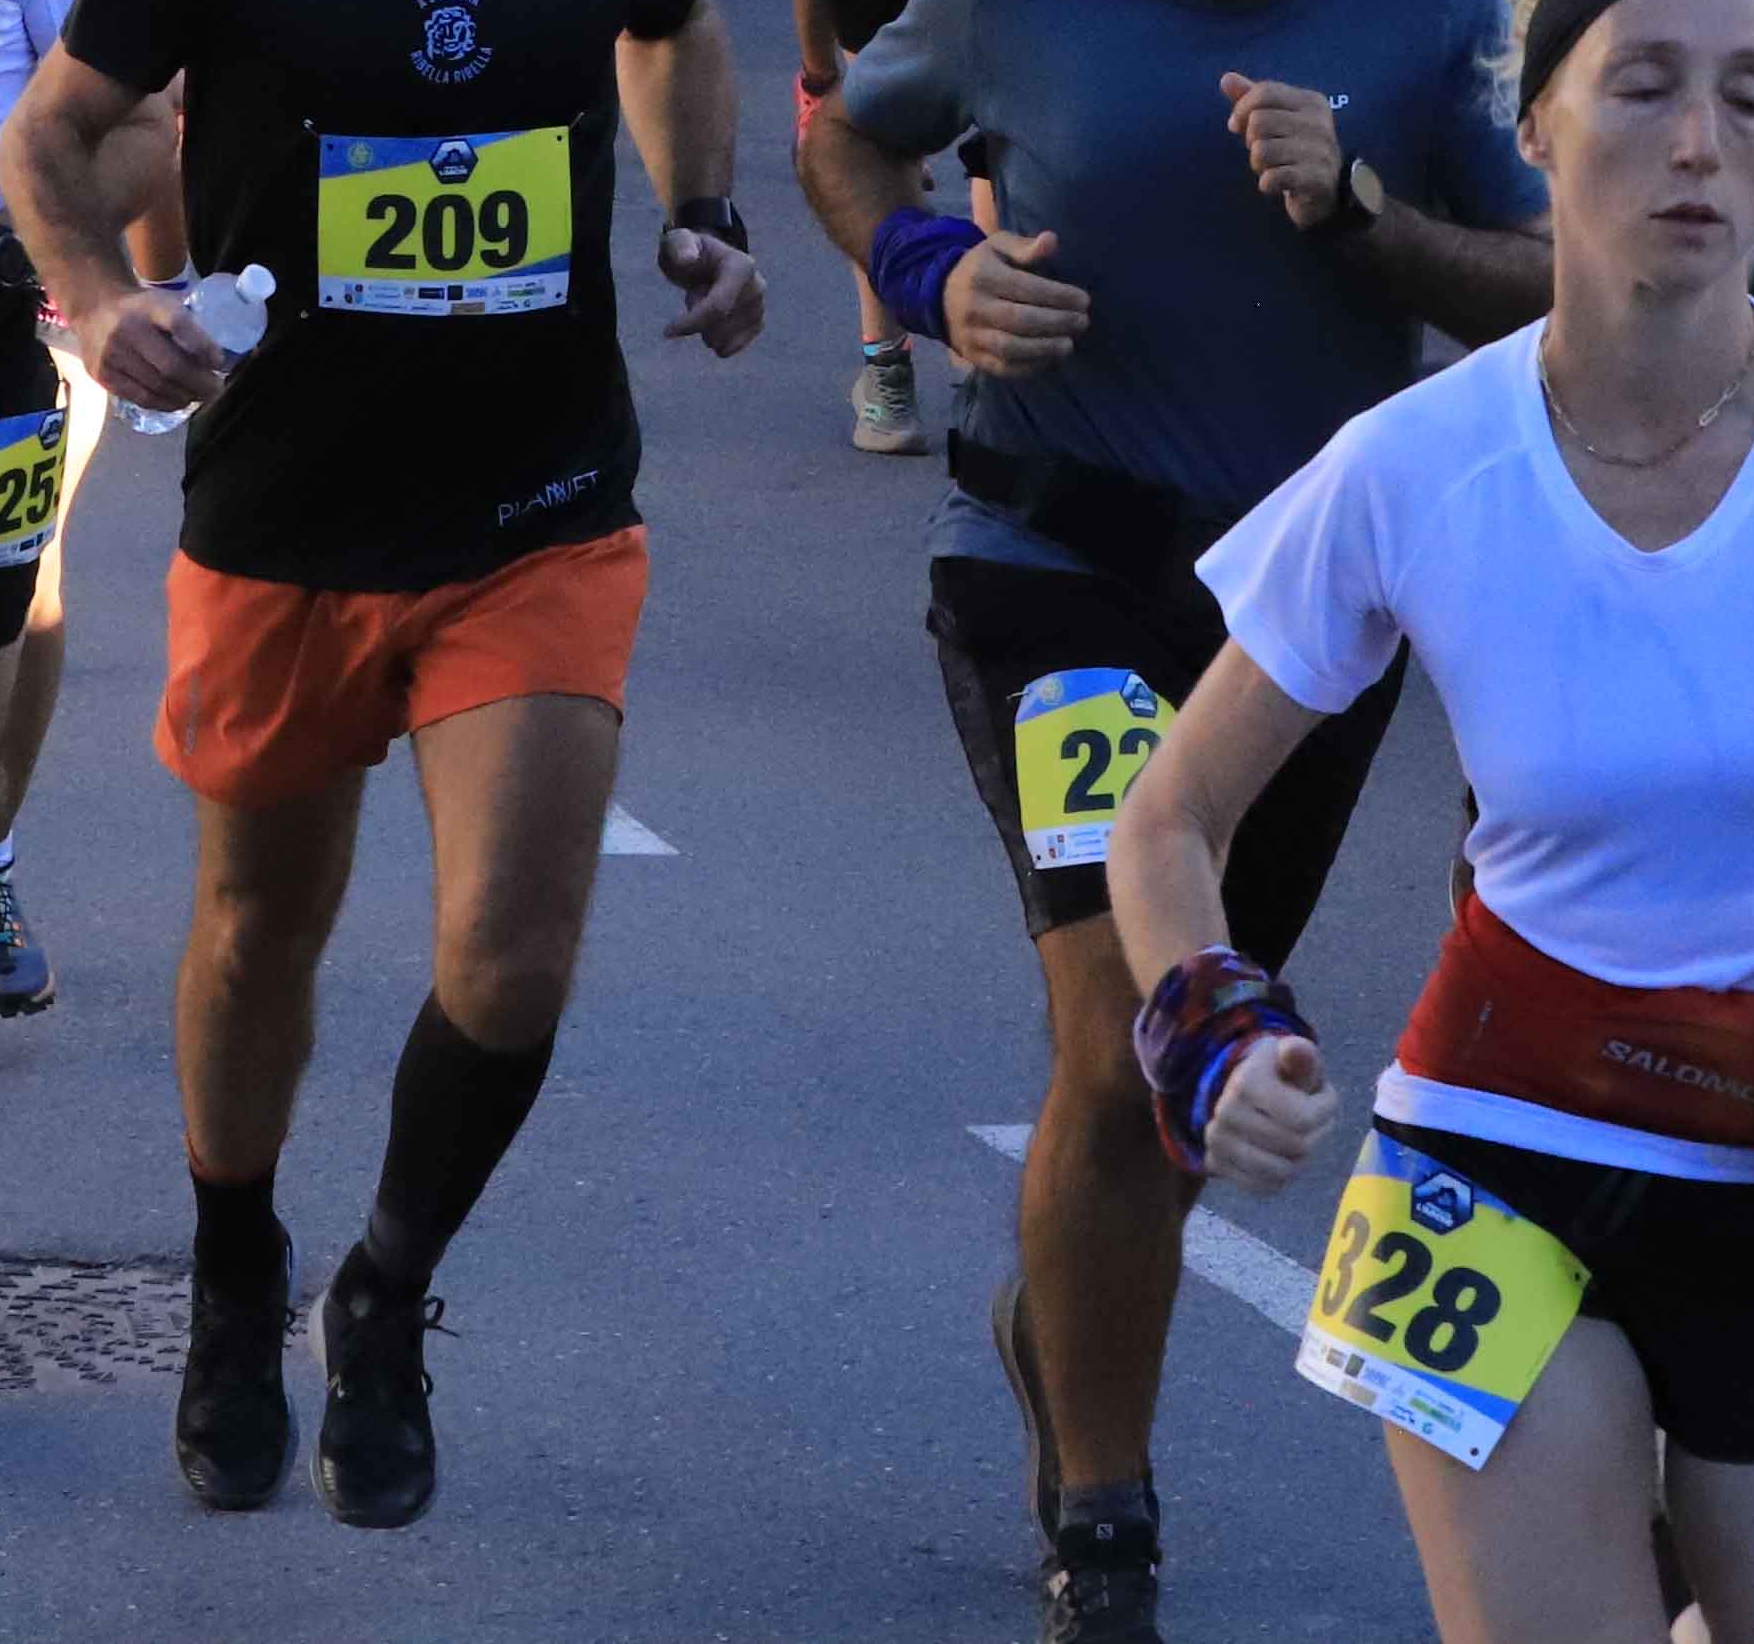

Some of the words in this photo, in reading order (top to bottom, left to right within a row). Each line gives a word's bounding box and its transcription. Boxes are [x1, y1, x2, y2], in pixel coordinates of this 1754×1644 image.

[365, 190, 528, 271] 209
[1061, 727, 1162, 814] 22
[1322, 1210, 1501, 1372] 328
